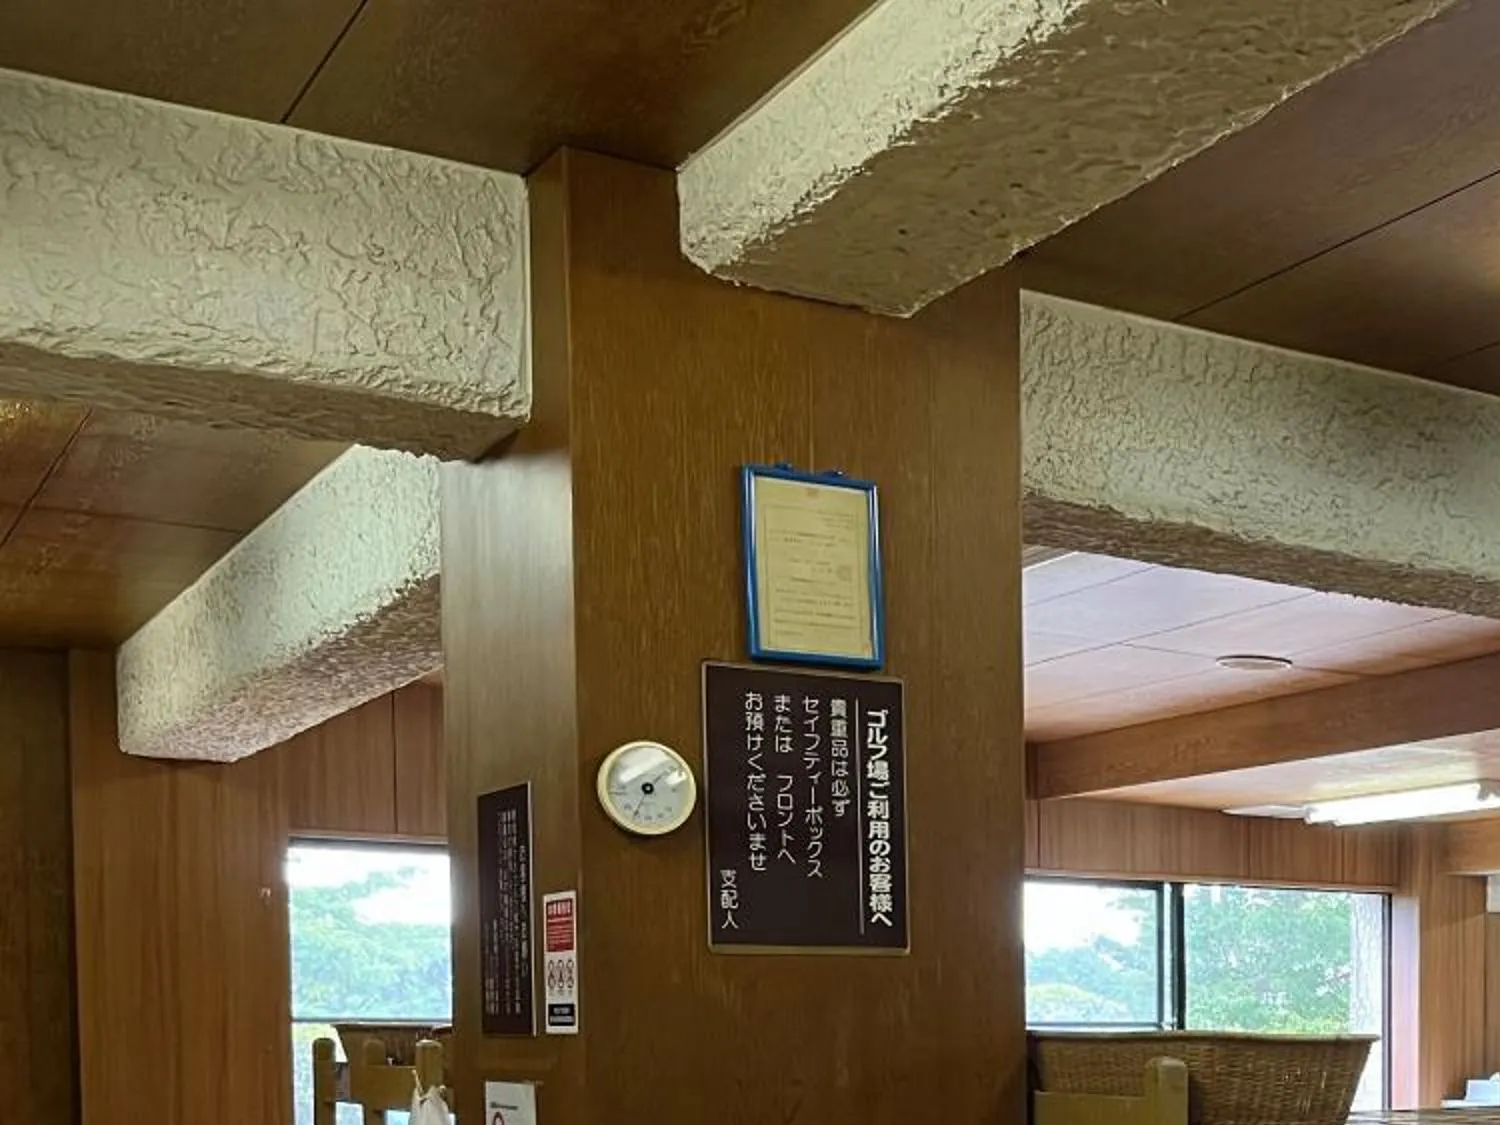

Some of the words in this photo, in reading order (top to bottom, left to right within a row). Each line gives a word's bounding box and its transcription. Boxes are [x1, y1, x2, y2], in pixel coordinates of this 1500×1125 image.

[745, 691, 767, 872] お預けくださいませ
[774, 694, 795, 753] または
[829, 699, 851, 818] 貴重品は必ず
[775, 775, 796, 864] フロントへ
[802, 696, 824, 878] セイフティーボックス
[866, 709, 893, 927] ゴルフ場ご利用のお客様へ
[720, 870, 739, 930] 支配人
